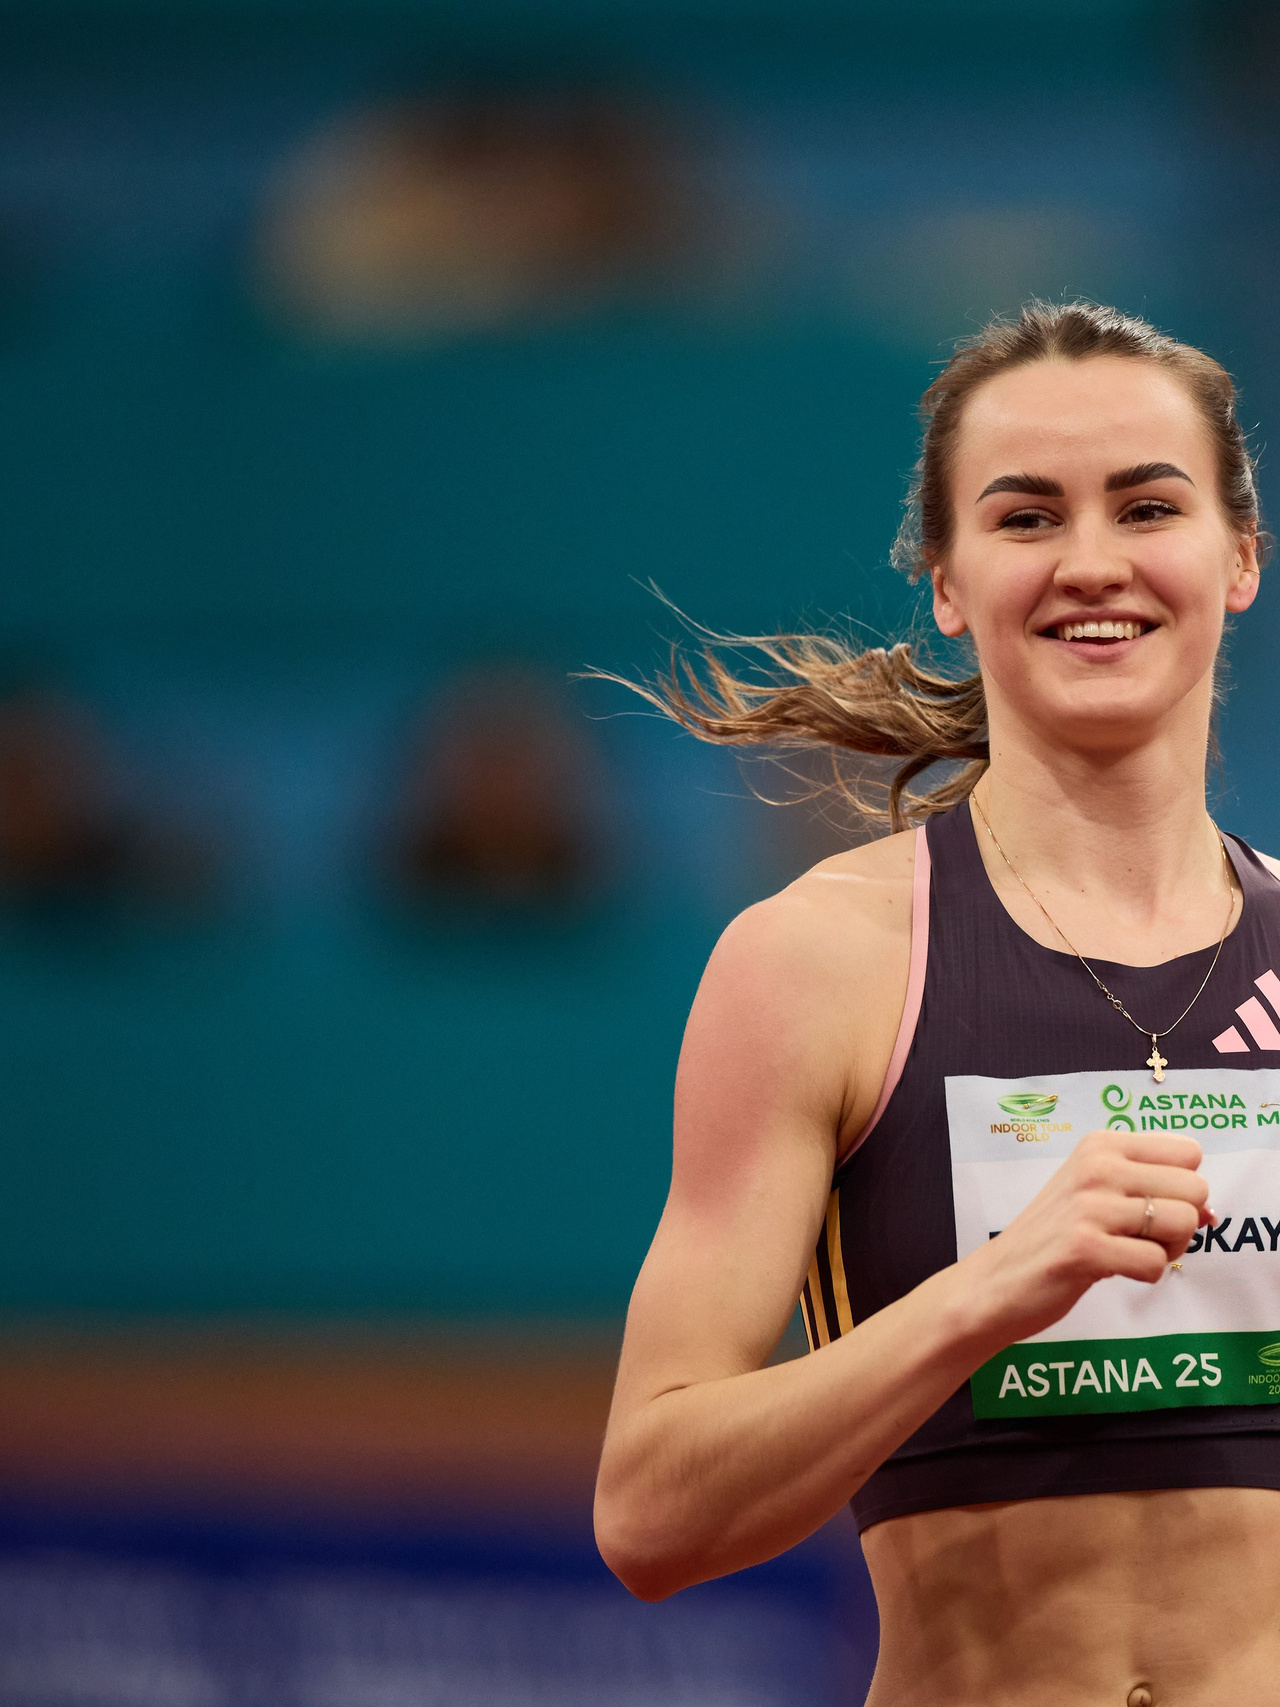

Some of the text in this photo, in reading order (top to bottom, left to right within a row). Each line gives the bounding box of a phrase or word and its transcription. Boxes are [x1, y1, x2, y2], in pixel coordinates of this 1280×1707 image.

[1138, 1094, 1246, 1110] ASTANA
[990, 1122, 1072, 1133] INDOOR TOUR
[1141, 1114, 1247, 1130] INDOOR
[1016, 1132, 1050, 1143] GOLD
[998, 1353, 1222, 1398] ASTANA 25
